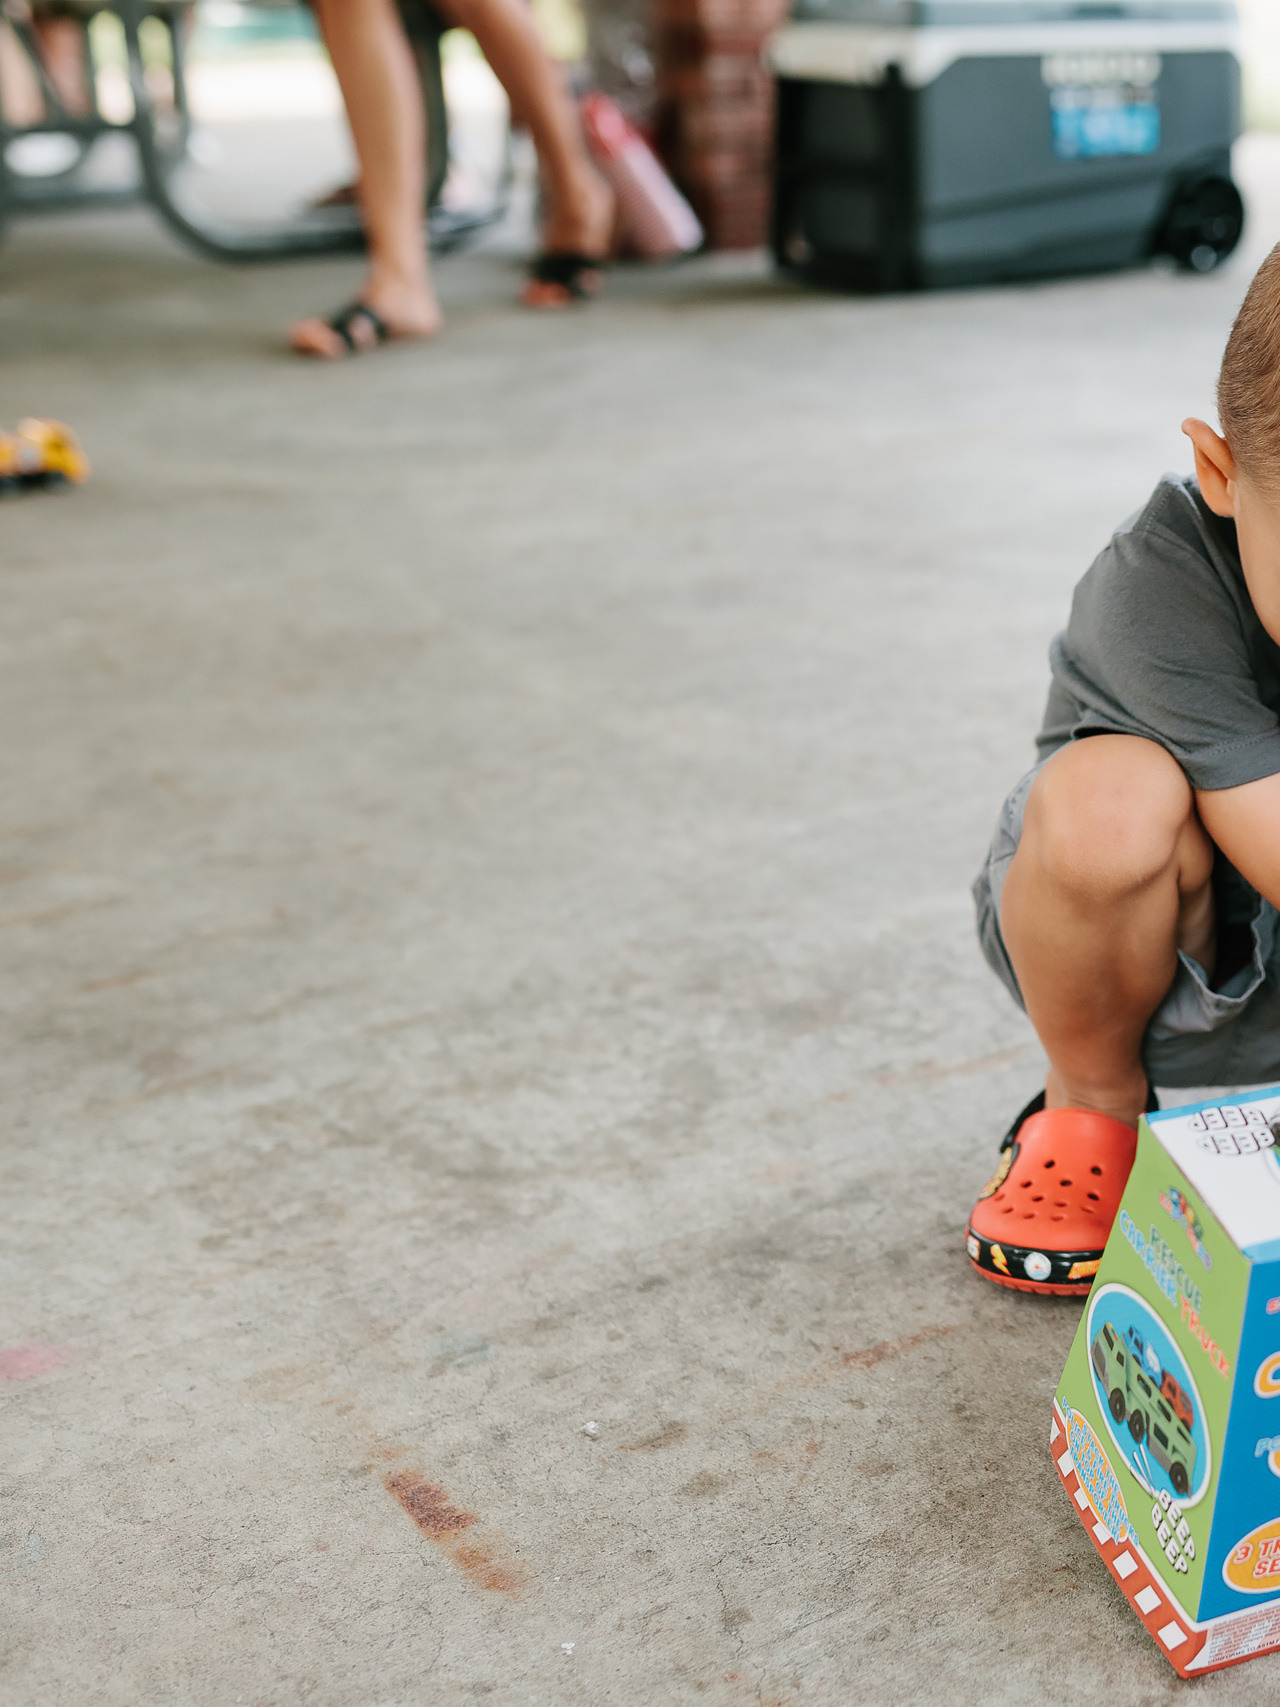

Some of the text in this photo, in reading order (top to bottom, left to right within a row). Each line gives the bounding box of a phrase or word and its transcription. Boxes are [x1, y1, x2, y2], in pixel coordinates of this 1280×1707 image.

[1120, 1210, 1178, 1307] CARRIER
[1180, 1295, 1231, 1379] TRUCK
[1150, 1225, 1201, 1314] RESCUE
[1062, 1396, 1087, 1447] POLICE
[1092, 1456, 1110, 1491] FIRE
[1109, 1488, 1140, 1546] TRUCKS
[1070, 1430, 1123, 1531] ON TOP OF THE
[1082, 1422, 1120, 1495] STACK THE
[1151, 1502, 1188, 1574] BEEP
[1159, 1488, 1196, 1561] BEEP
[1233, 1543, 1253, 1564] 3
